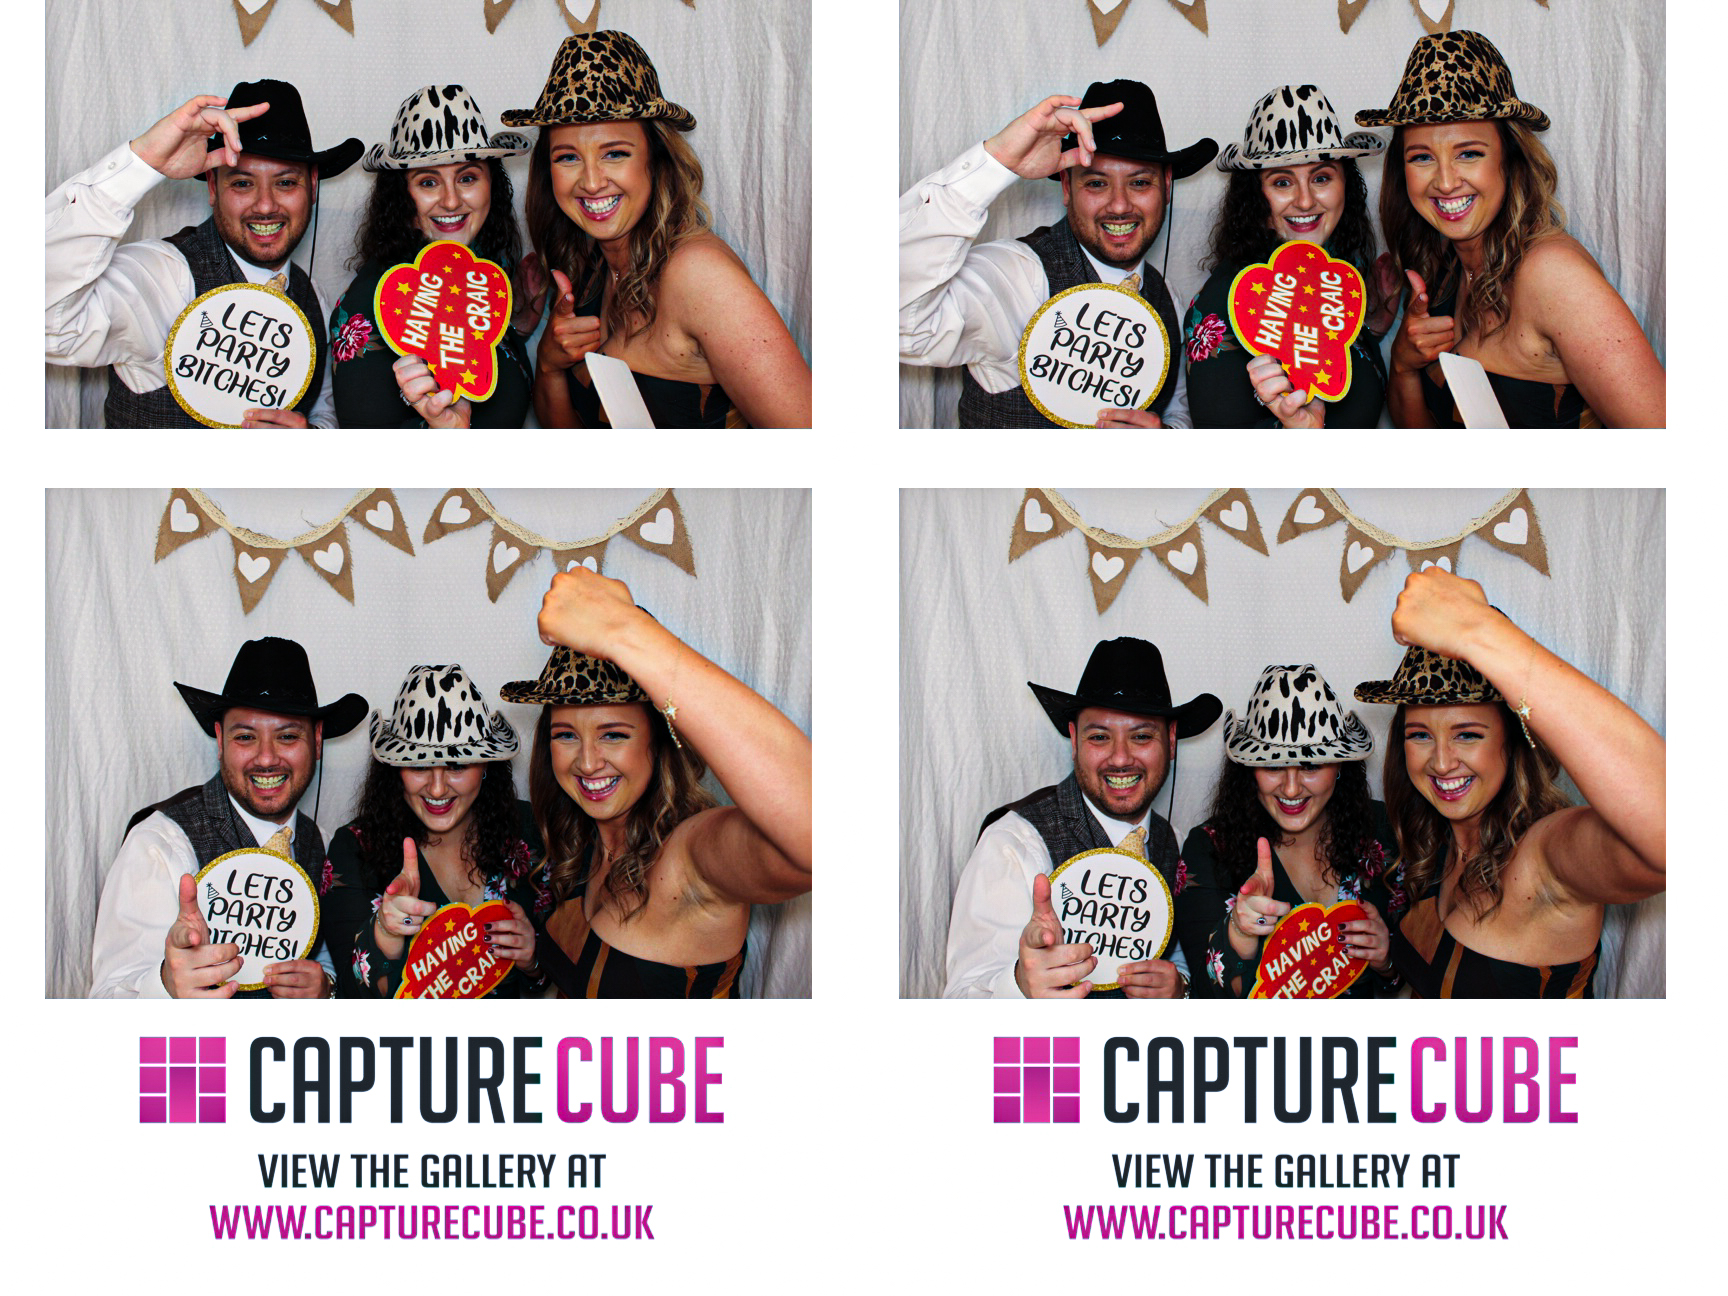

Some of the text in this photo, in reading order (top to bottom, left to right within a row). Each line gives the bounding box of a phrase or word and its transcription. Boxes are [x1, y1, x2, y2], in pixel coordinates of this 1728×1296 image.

[221, 302, 293, 349] LETS
[400, 272, 444, 349] HAVING
[439, 271, 491, 369] THE CRAIC
[1075, 302, 1147, 349] LETS
[1254, 272, 1298, 349] HAVING
[1293, 271, 1345, 369] THE CRAIC
[196, 327, 291, 378] PARTY
[1050, 327, 1145, 378] PARTY
[175, 354, 287, 410] BITCHES!
[1029, 354, 1141, 410] BITCHES!
[226, 869, 294, 904] LETS
[1080, 869, 1148, 904] LETS
[207, 897, 297, 932] PARTY
[1061, 897, 1151, 932] PARTY
[208, 927, 298, 961] ITCHES!
[411, 922, 478, 982] HAVING
[458, 944, 499, 995] CRAI
[1062, 927, 1152, 961] ITCHES!
[1265, 922, 1332, 982] HAVING
[1312, 944, 1353, 995] CRAI
